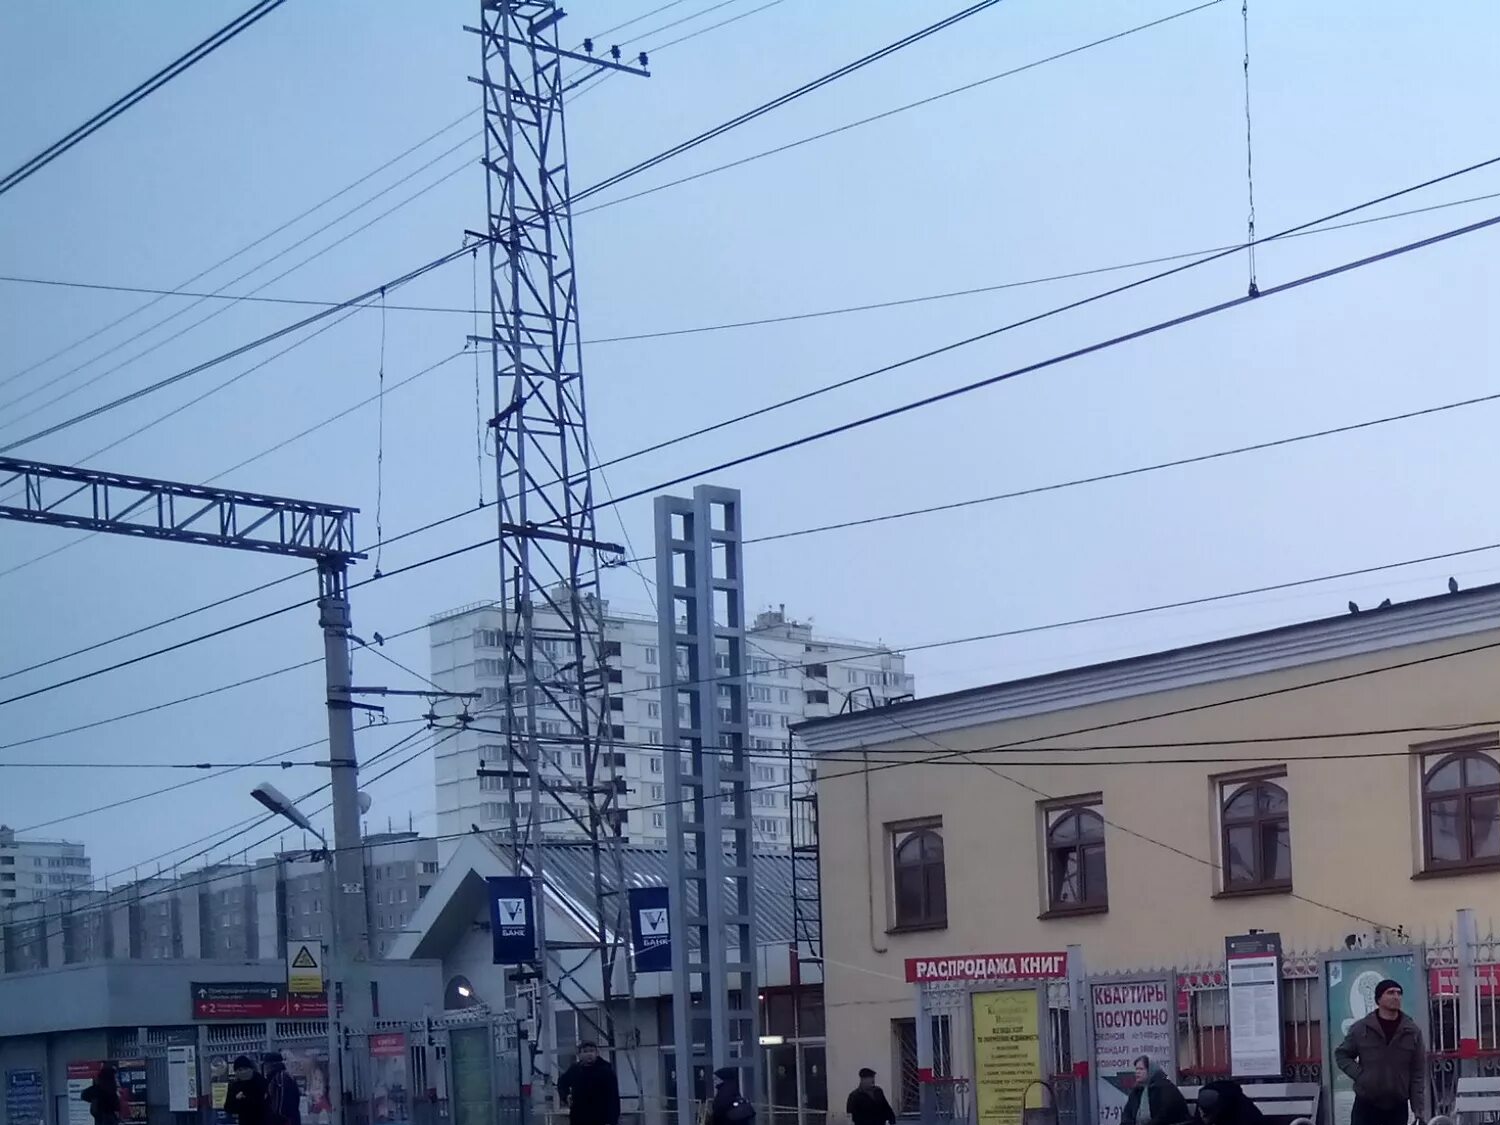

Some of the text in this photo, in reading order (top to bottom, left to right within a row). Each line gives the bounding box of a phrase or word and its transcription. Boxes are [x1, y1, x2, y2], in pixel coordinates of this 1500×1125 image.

[916, 956, 1064, 979] РАСПРОДАЖА КНИГ
[1094, 984, 1167, 1005] КВАРТИРЫ
[210, 1003, 216, 1013] 2
[1096, 1009, 1168, 1028] ПОСУТОЧНО
